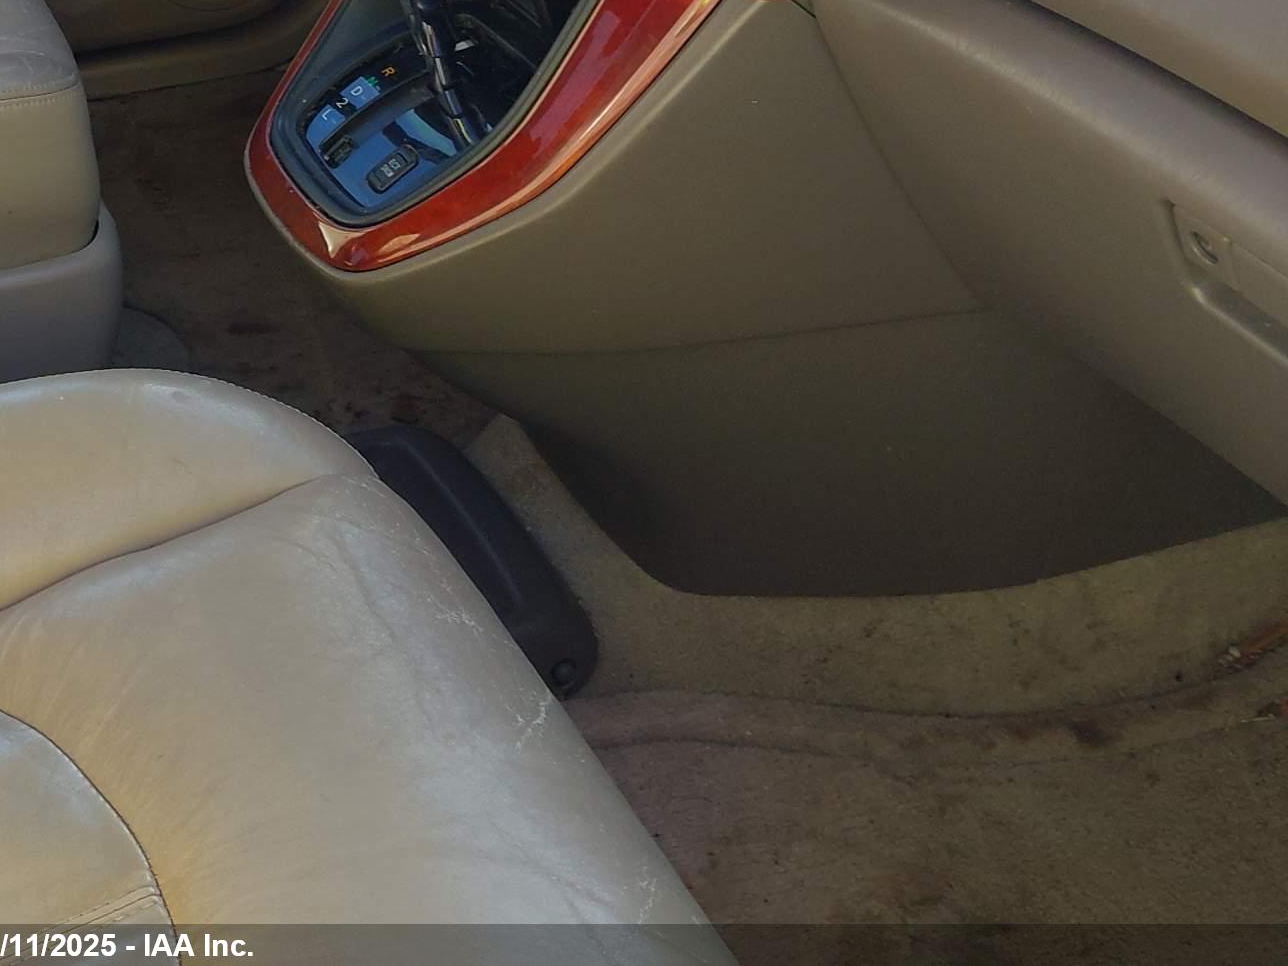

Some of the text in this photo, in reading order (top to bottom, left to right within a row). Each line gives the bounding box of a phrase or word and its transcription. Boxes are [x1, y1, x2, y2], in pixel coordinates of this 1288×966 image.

[380, 66, 396, 78] R
[350, 85, 363, 96] D
[335, 97, 349, 109] 2
[321, 108, 333, 121] L
